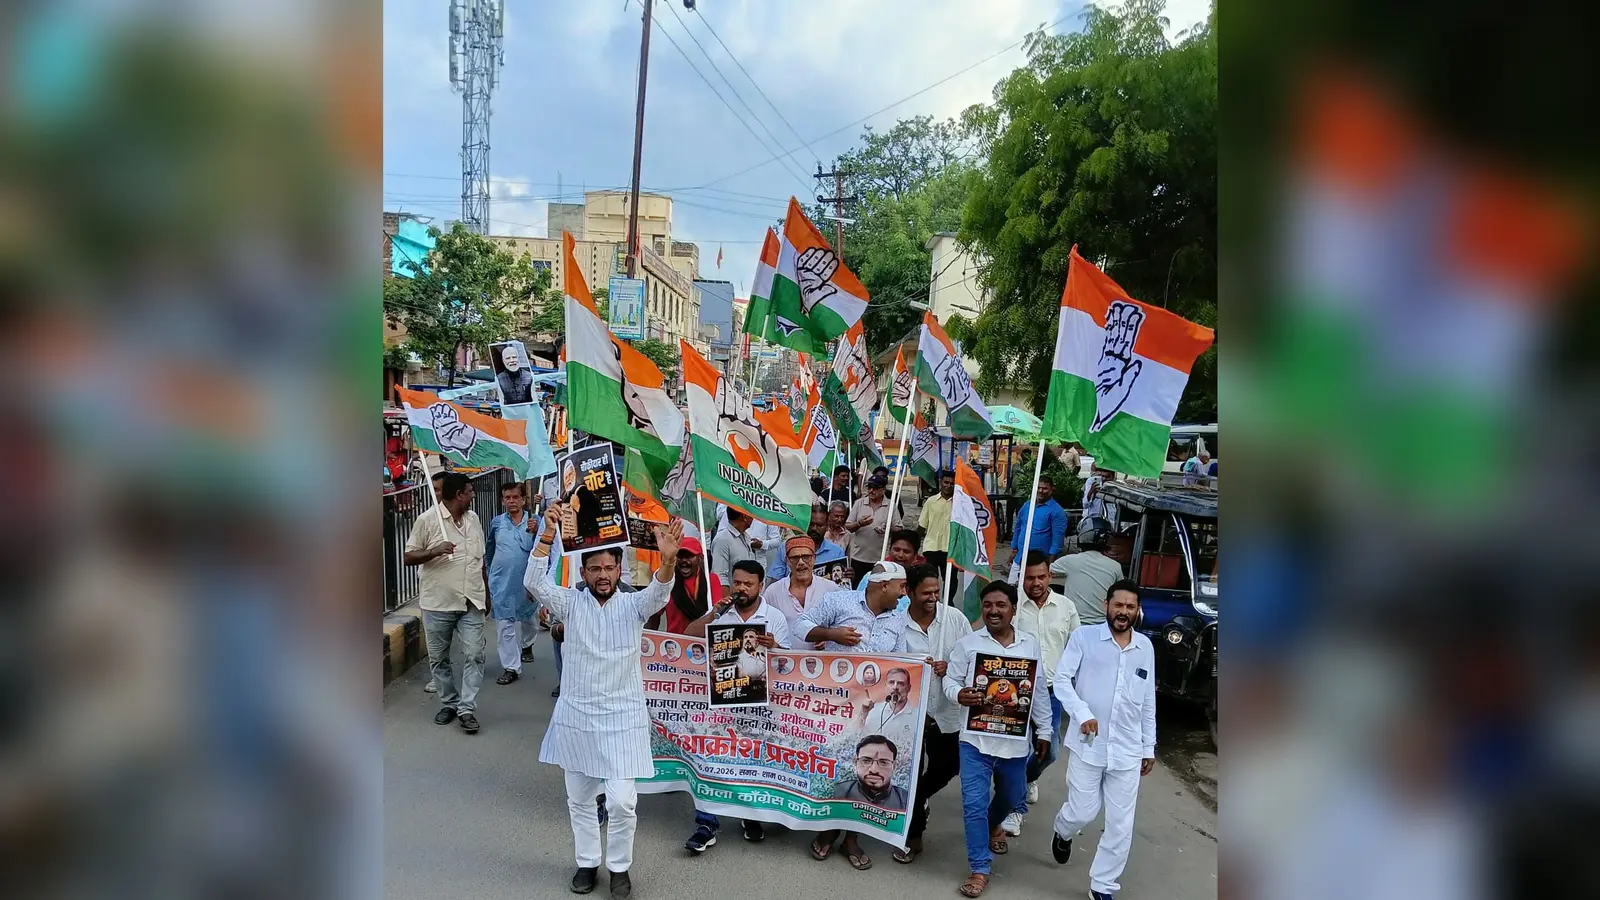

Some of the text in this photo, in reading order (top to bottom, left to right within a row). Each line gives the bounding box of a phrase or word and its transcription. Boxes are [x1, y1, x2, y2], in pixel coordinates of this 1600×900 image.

[584, 469, 606, 491] चोर
[718, 462, 764, 491] INDIAN
[712, 628, 735, 643] हम
[713, 638, 740, 652] डरने वाले
[715, 665, 736, 682] हम
[984, 657, 1030, 671] मुझे फर्क
[715, 675, 750, 694] झुकने वाले
[774, 680, 794, 691] उतरा
[798, 682, 804, 692] है
[808, 683, 832, 696] मैदान
[794, 695, 810, 711] की
[812, 698, 840, 716] ओर
[841, 702, 854, 719] से
[646, 698, 678, 710] भाजपा
[681, 700, 713, 711] सरका
[780, 712, 814, 728] अयोध्या
[829, 722, 844, 736] हुए
[658, 709, 688, 722] घोटाले
[691, 711, 705, 723] को
[708, 712, 733, 725] लेकर
[780, 723, 788, 735] के
[791, 726, 828, 744] खिलाफ
[766, 743, 838, 779] प्रदर्शन
[798, 780, 808, 789] बजे
[697, 784, 732, 799] जिला
[788, 799, 832, 816] कमिटी
[860, 812, 888, 826] अध्यक्ष
